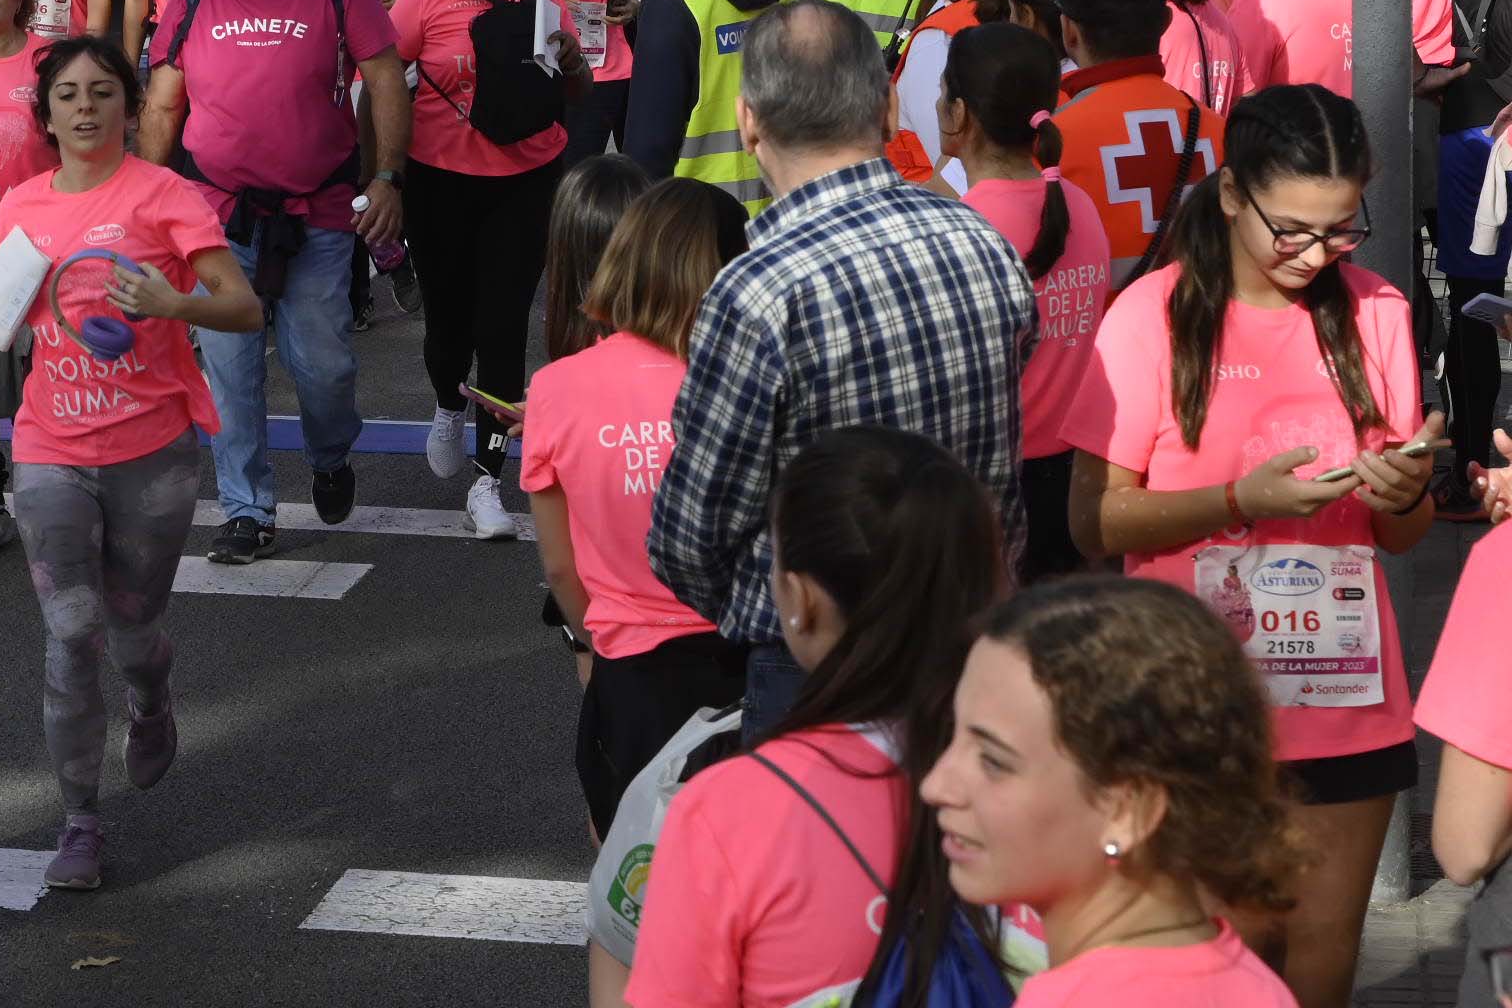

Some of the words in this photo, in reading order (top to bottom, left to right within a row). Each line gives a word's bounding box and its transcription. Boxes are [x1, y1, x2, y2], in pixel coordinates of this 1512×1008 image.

[211, 17, 309, 40] CHANETE
[1049, 293, 1071, 318] DE
[1075, 288, 1094, 312] LA
[44, 349, 147, 383] DORSAL
[53, 385, 133, 418] SUMA
[598, 421, 674, 448] CARR
[625, 445, 660, 471] DE
[1256, 573, 1320, 587] ASTURIANA
[1330, 567, 1362, 576] SUMA
[1261, 609, 1321, 633] 016
[1266, 640, 1316, 654] 21578
[1272, 663, 1286, 671] DE
[1288, 663, 1302, 671] LA
[1304, 662, 1339, 672] MUJER
[1342, 662, 1365, 670] 2023
[1316, 683, 1369, 695] Santander
